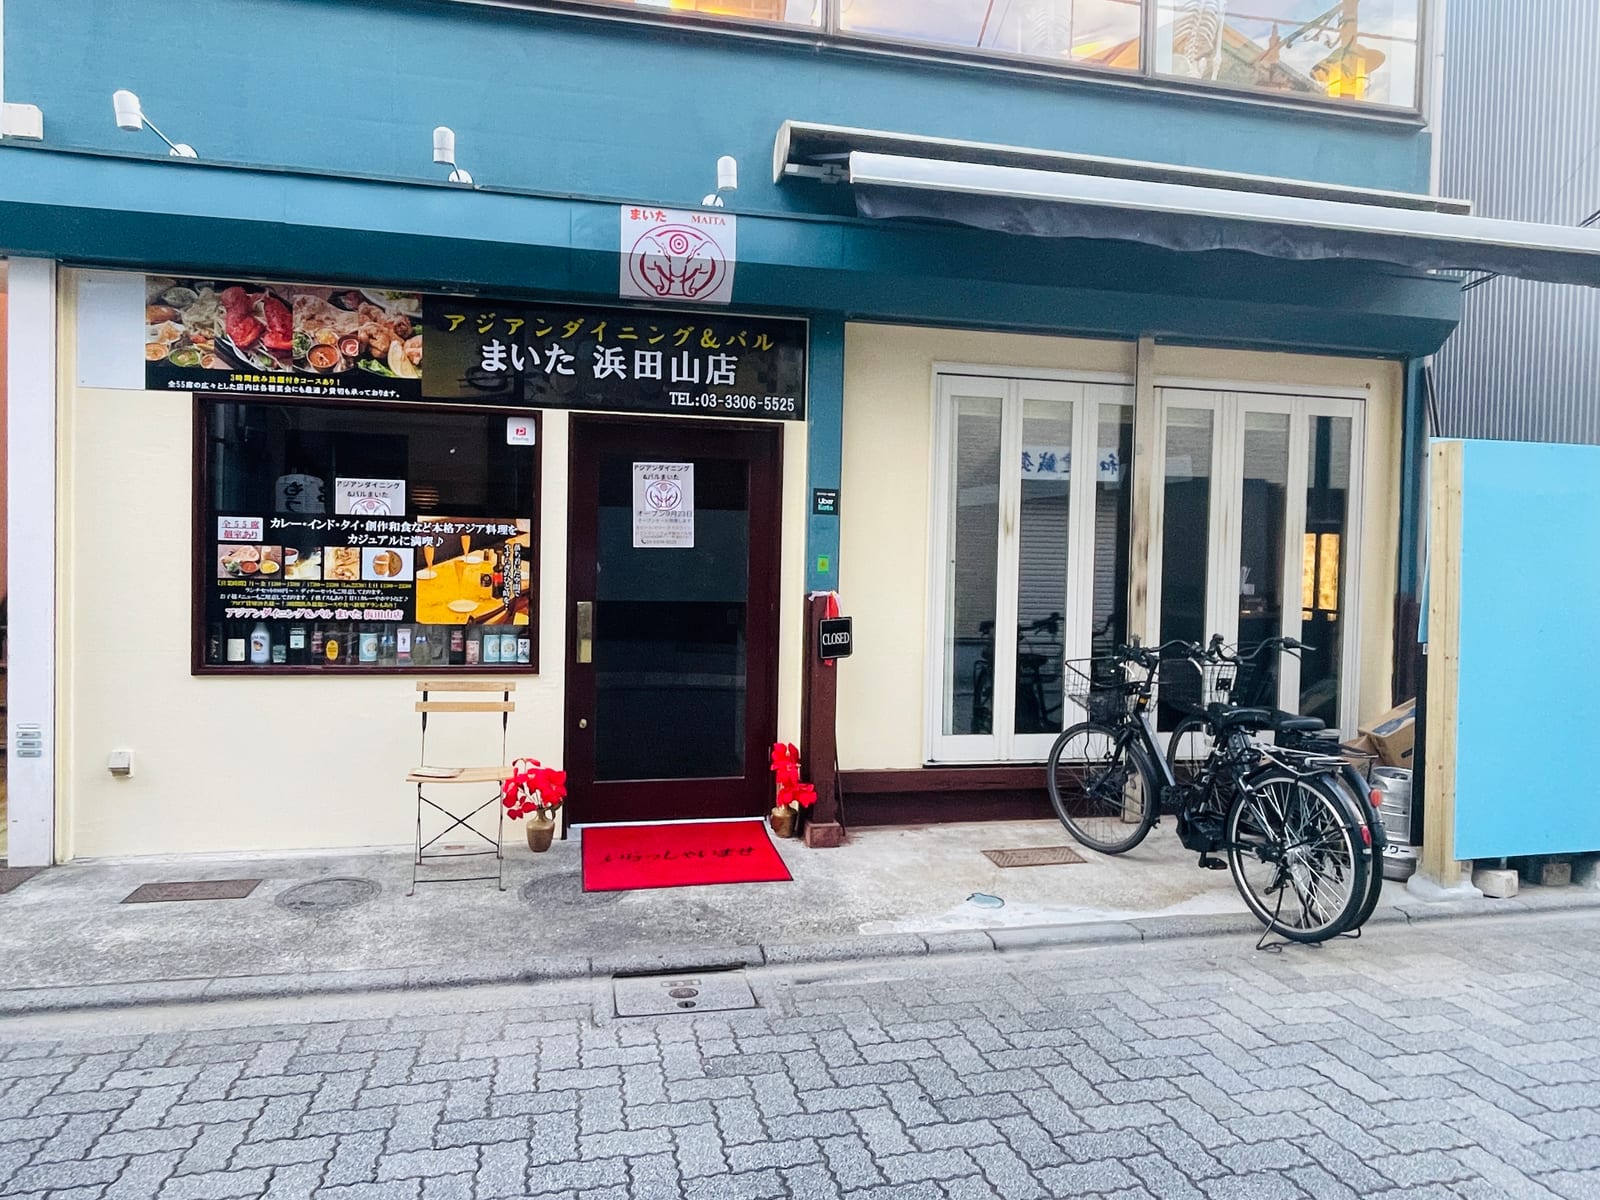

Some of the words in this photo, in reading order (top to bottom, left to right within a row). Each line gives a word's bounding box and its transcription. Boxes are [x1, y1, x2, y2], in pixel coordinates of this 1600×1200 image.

[630, 208, 667, 222] まいた
[691, 215, 726, 225] MAITA
[443, 313, 775, 352] アジアンダイニング&バル
[481, 338, 576, 375] まいた
[592, 344, 739, 385] 浜田山店
[669, 392, 795, 412] TEL:03-3306-5525
[336, 480, 400, 489] アジアンダイニング
[335, 609, 362, 620] まいた
[822, 632, 850, 645] CLOSED
[604, 846, 756, 863] いらっしゃいませ
